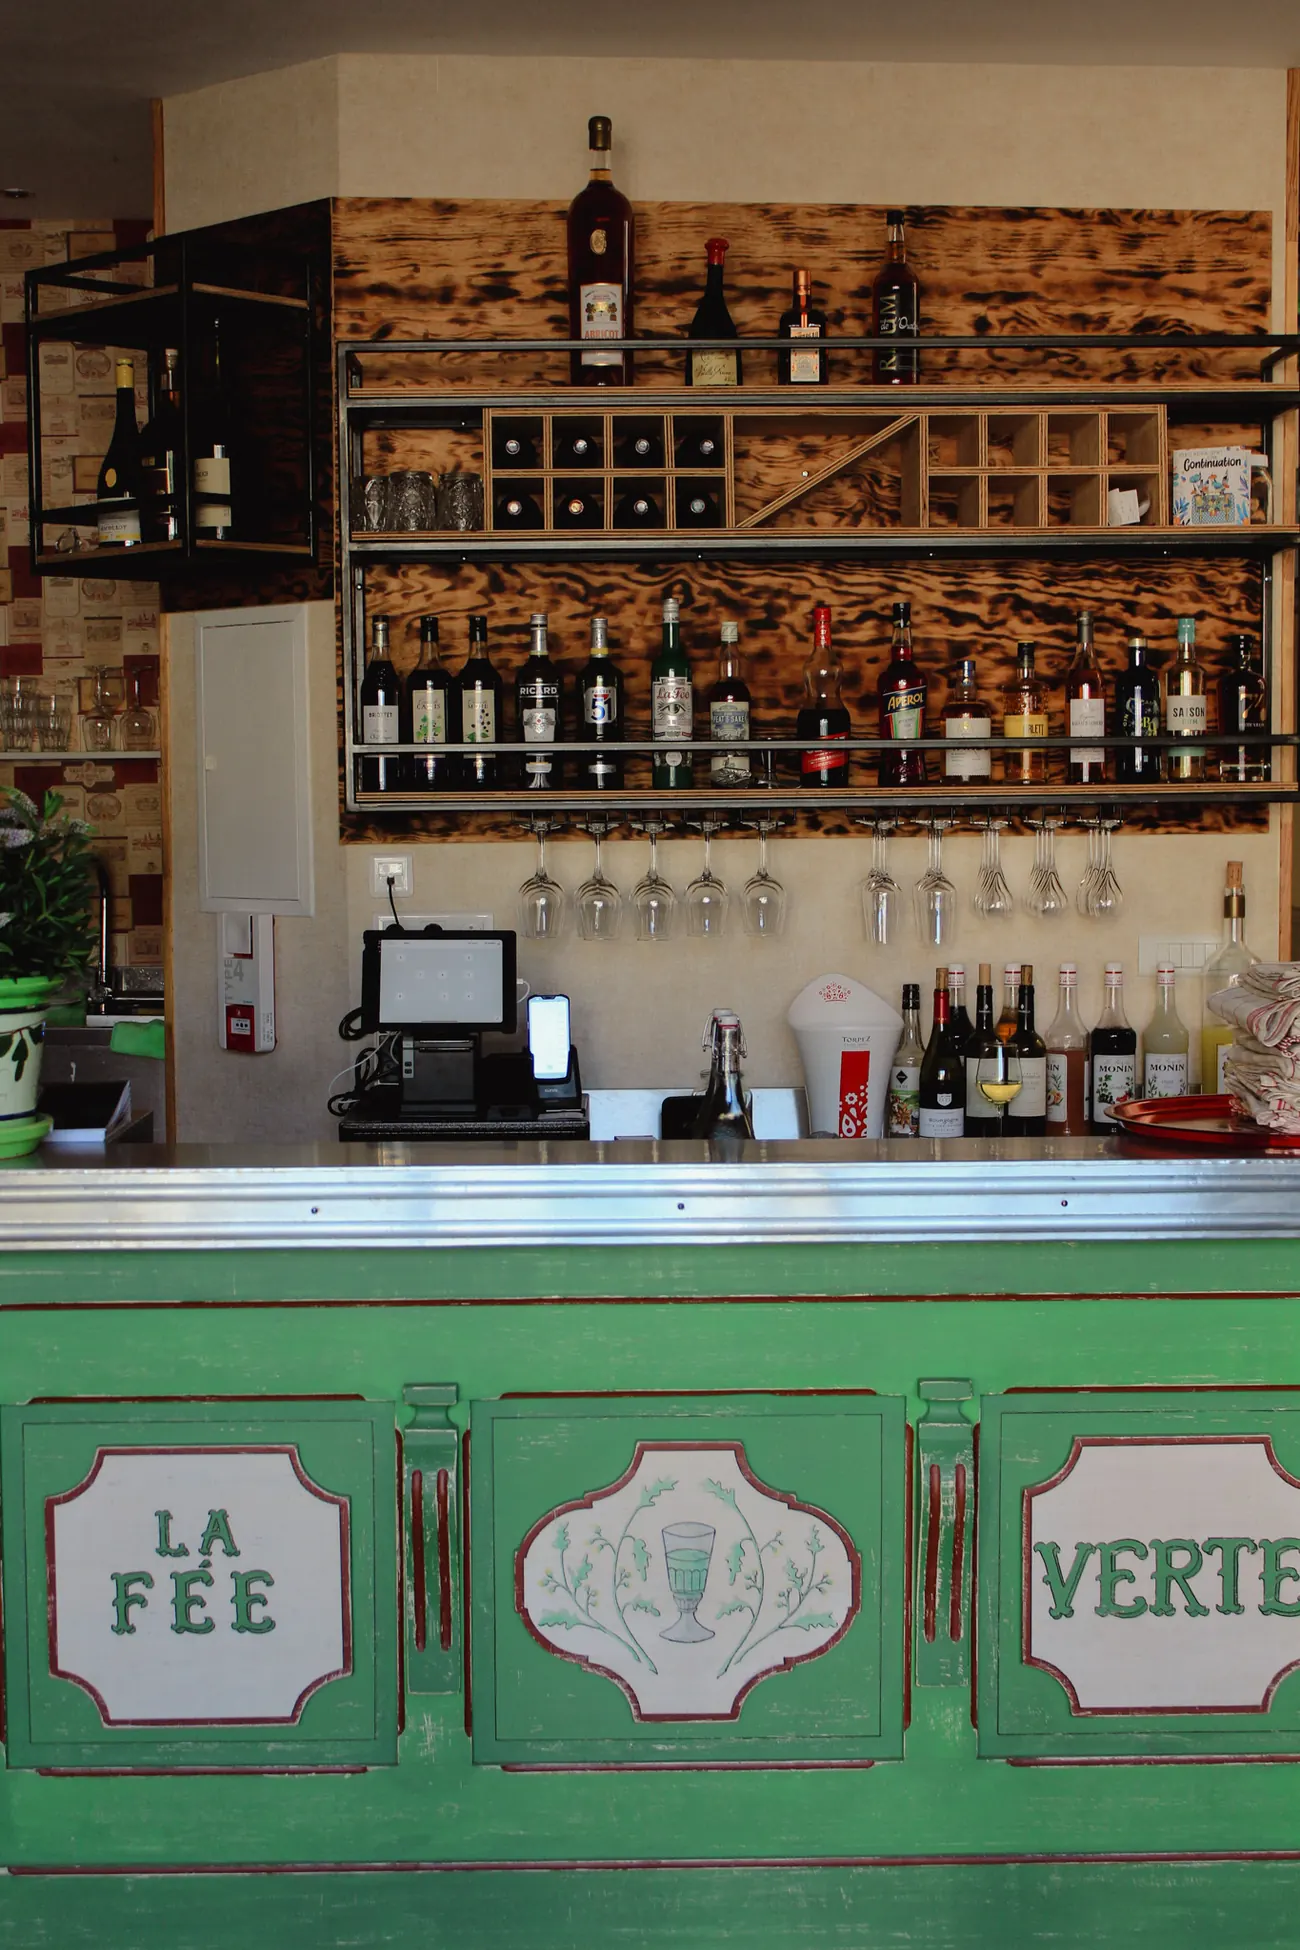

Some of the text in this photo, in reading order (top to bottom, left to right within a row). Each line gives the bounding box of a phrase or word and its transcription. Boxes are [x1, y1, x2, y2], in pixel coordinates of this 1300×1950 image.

[584, 330, 619, 339] ABRICOT
[1183, 456, 1242, 472] Continuation
[520, 687, 558, 695] RICARD
[591, 698, 612, 721] 51
[887, 692, 923, 711] APEROL
[1172, 706, 1205, 718] SAISON
[233, 960, 244, 982] 4
[1099, 1065, 1134, 1073] MONIN
[1149, 1063, 1185, 1072] MONIN
[154, 1509, 240, 1557] LA
[1033, 1537, 1300, 1620] VERTE
[110, 1559, 277, 1635] FÉE
